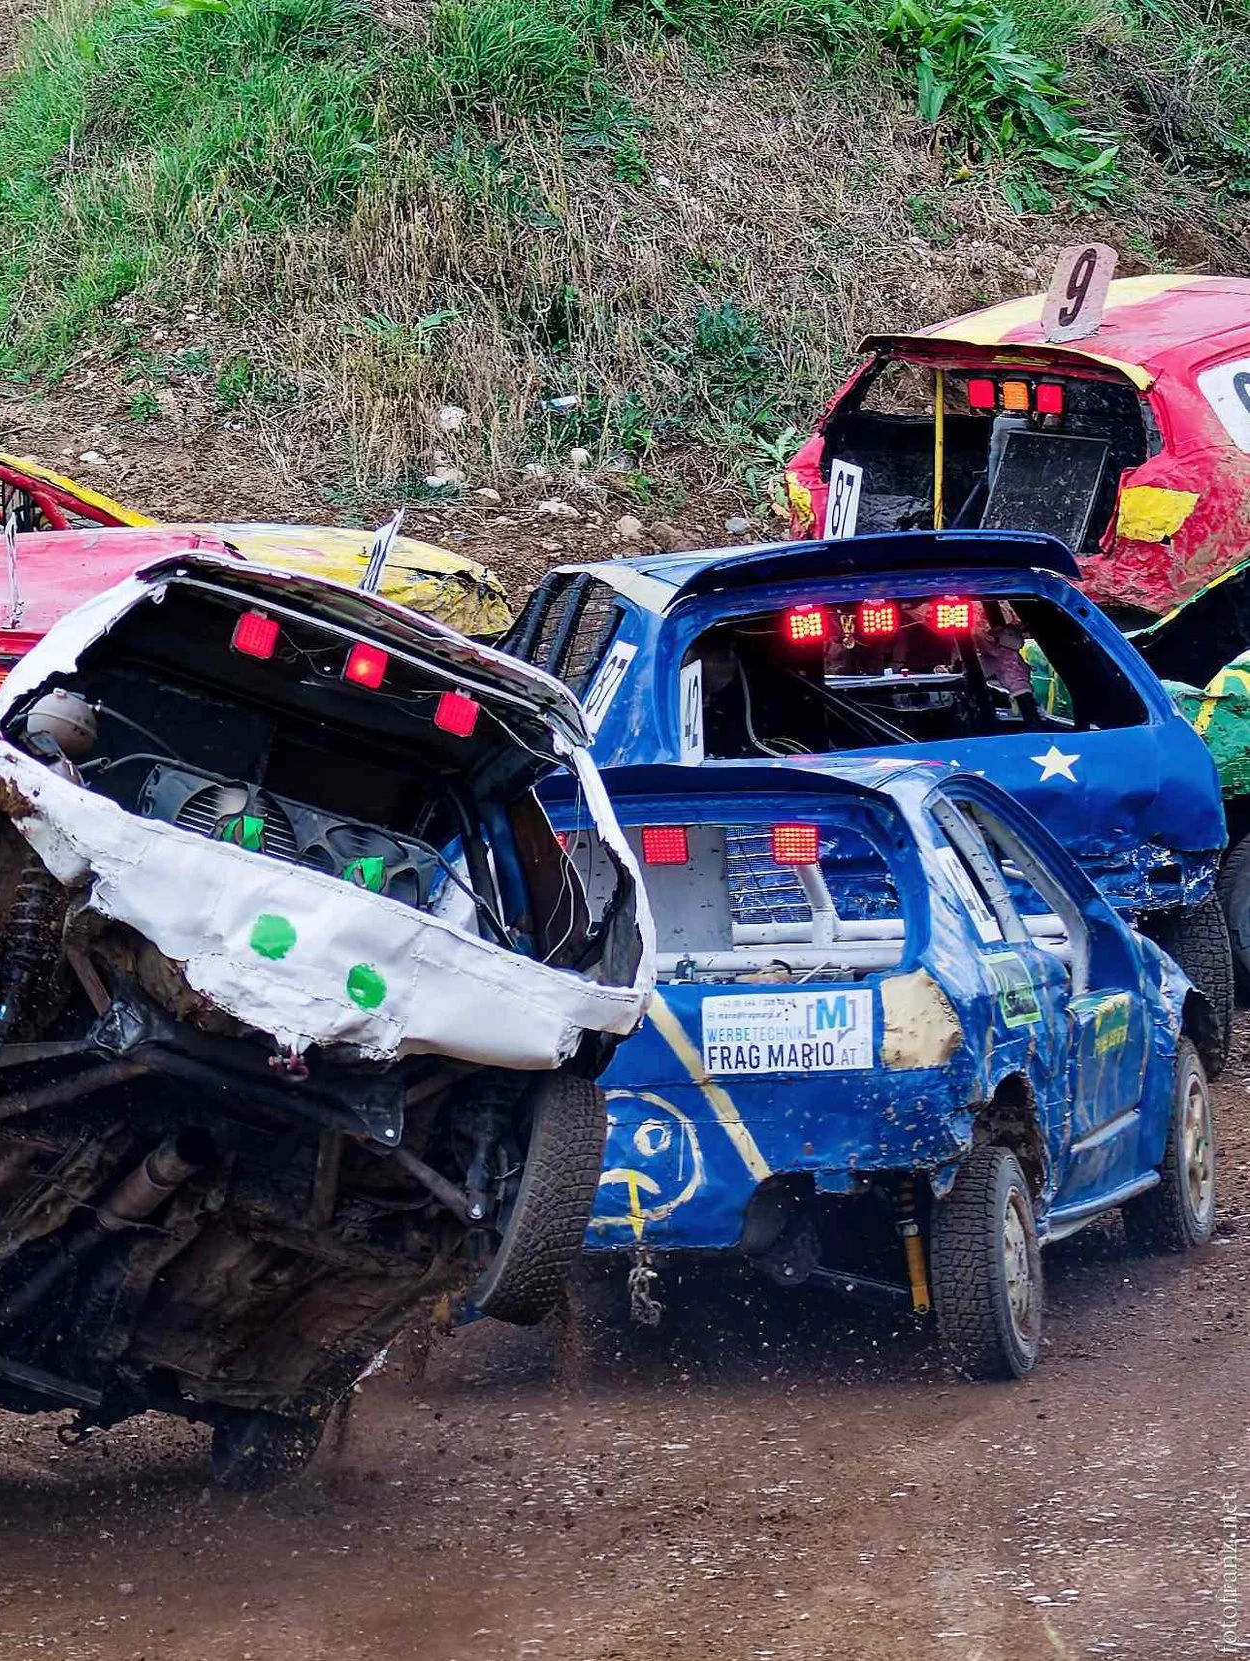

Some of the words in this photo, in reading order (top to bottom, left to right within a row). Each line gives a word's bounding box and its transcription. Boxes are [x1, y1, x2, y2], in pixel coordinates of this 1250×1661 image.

[1059, 248, 1097, 327] 9
[832, 470, 855, 540] 87
[586, 656, 628, 717] 87
[706, 1026, 806, 1043] WERBETECHNIK
[708, 1045, 760, 1070] FRAG
